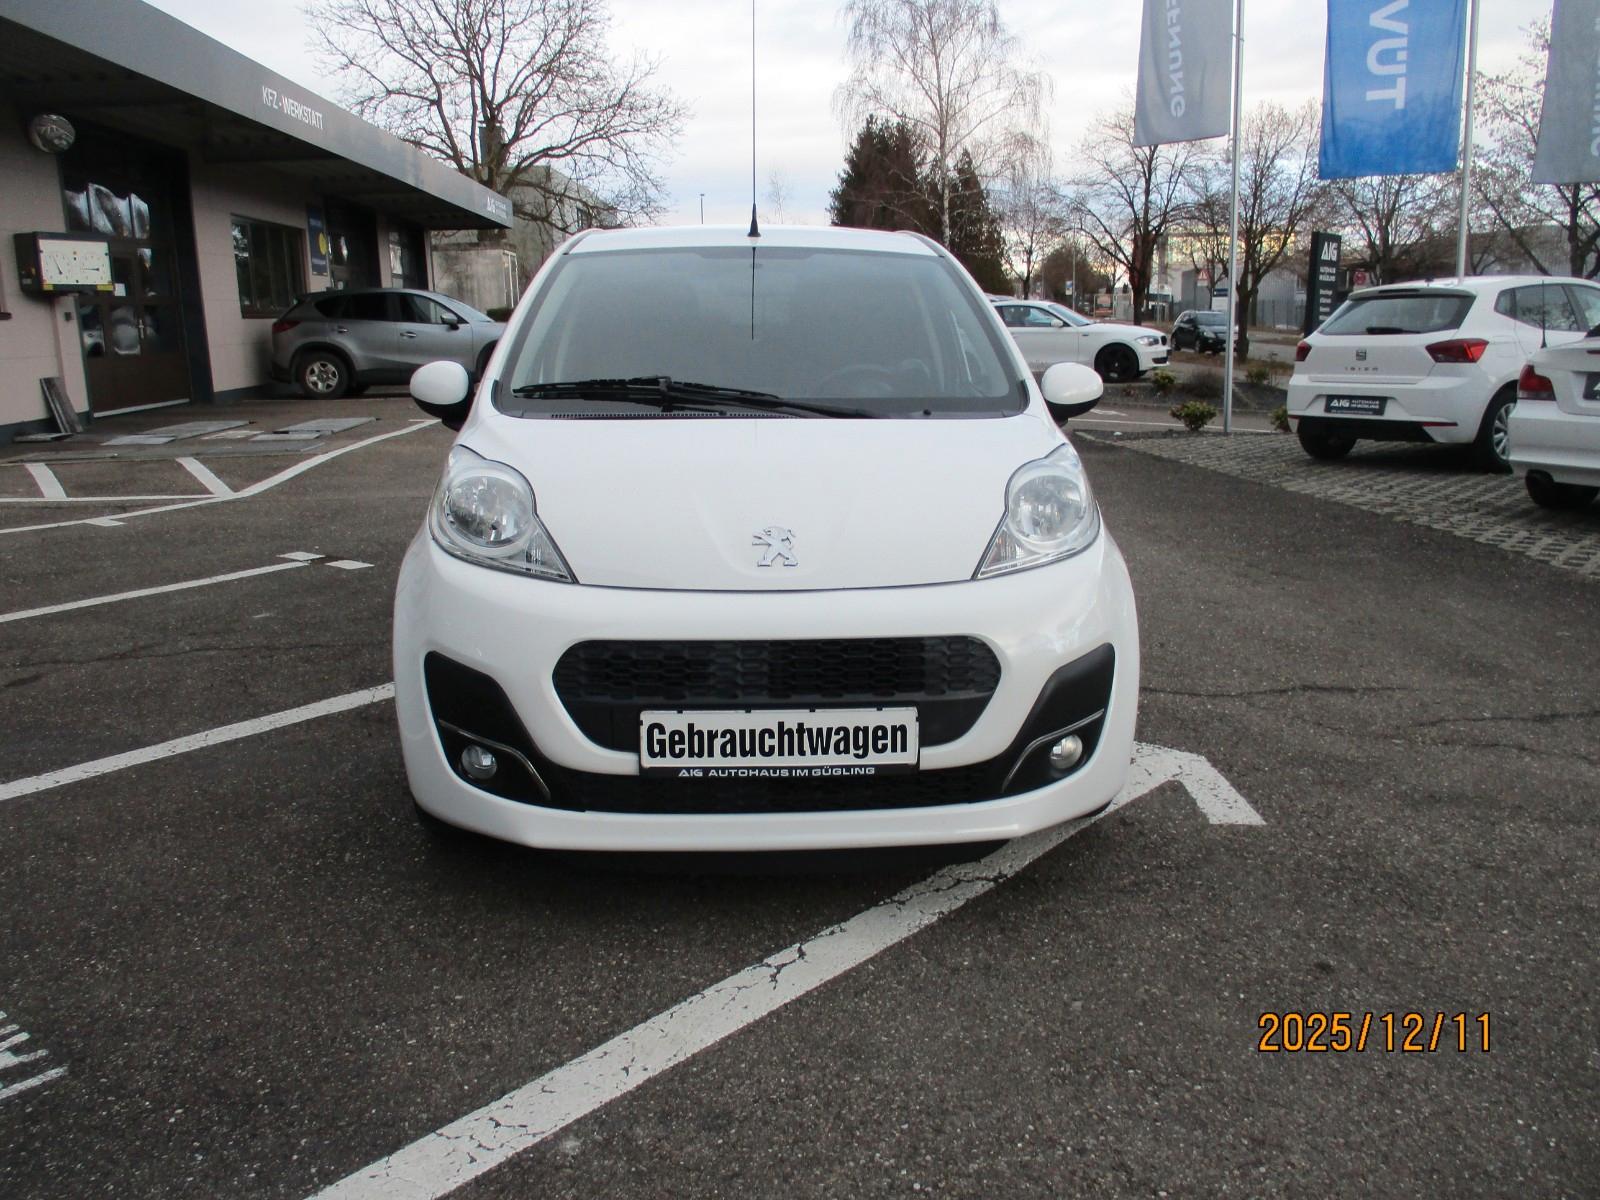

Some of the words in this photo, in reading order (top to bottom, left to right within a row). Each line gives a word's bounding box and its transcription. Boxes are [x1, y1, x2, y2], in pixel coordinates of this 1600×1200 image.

[1321, 241, 1338, 261] AIG
[1330, 400, 1350, 408] AIG
[646, 721, 908, 759] Gebrauchtwagen
[678, 769, 703, 777] AIG
[708, 769, 789, 777] AUTOHAUS
[792, 769, 809, 777] IM
[811, 765, 875, 777] GÜGLING
